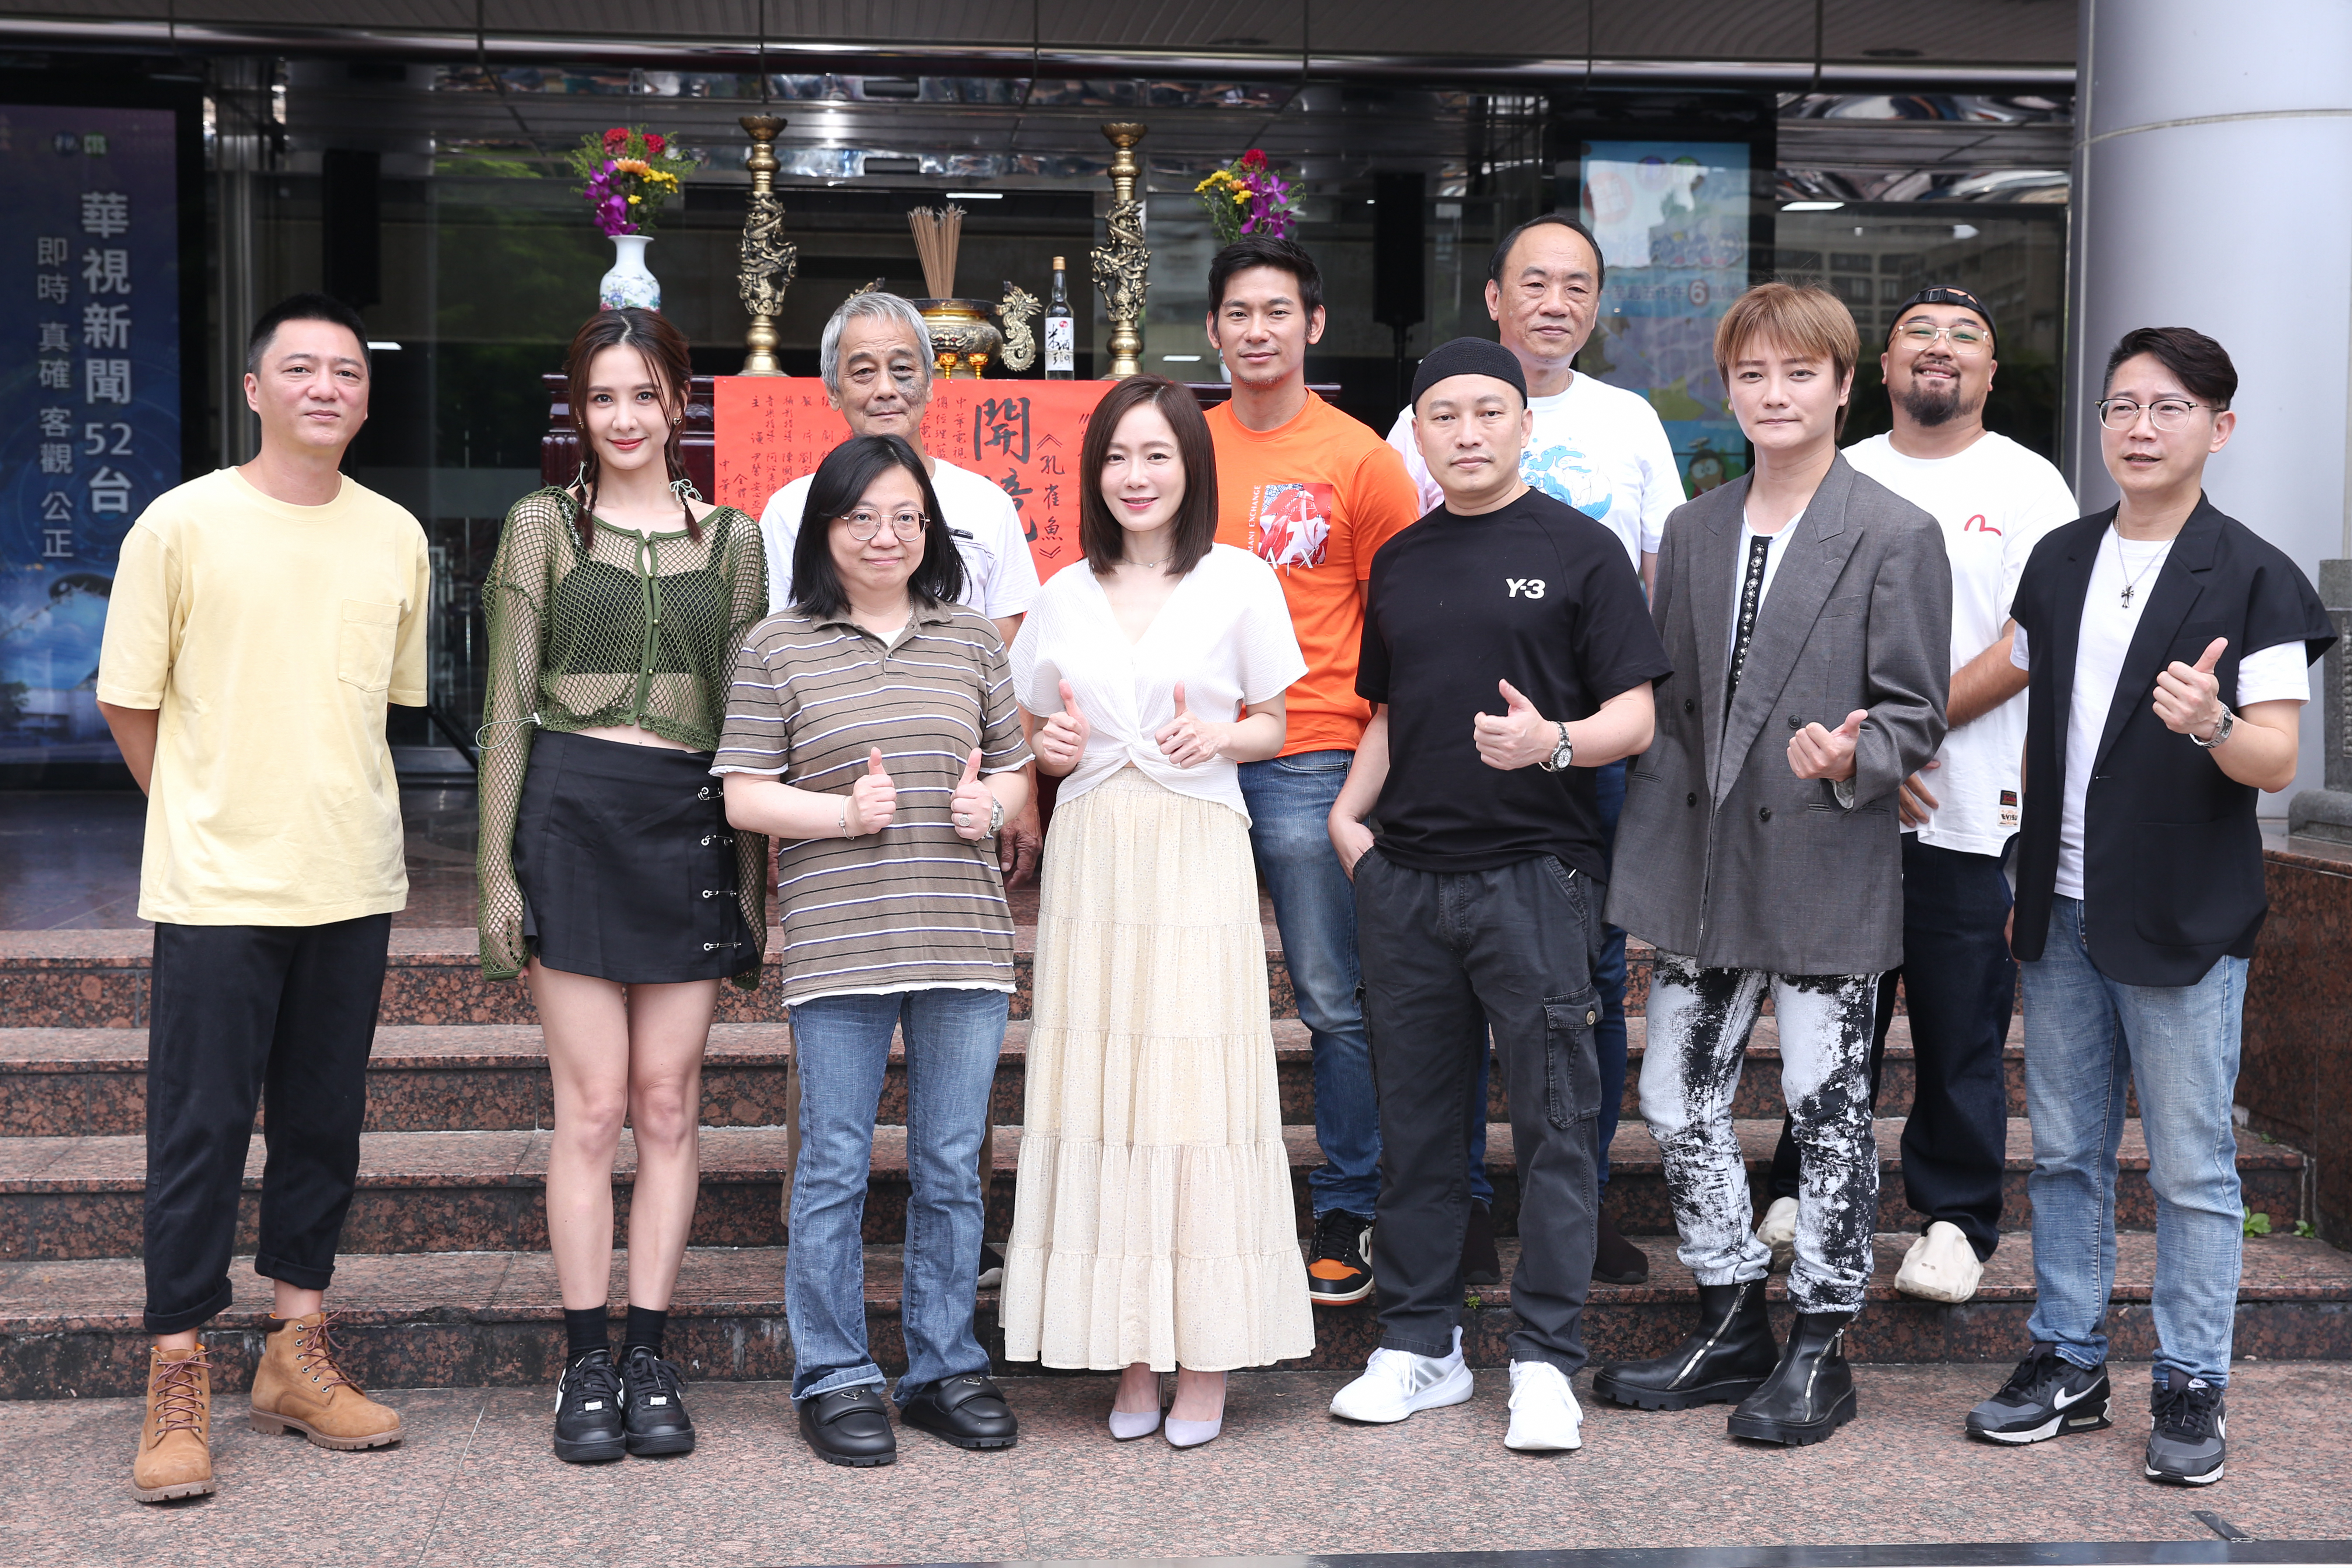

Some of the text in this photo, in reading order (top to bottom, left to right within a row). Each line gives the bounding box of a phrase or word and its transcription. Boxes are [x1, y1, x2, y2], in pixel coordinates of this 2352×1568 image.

[37, 237, 74, 558] 即時 真確 客觀 公正
[81, 191, 133, 513] 華視新聞52台
[1249, 485, 1261, 527] EXCHANGE
[1505, 578, 1546, 599] Y-3
